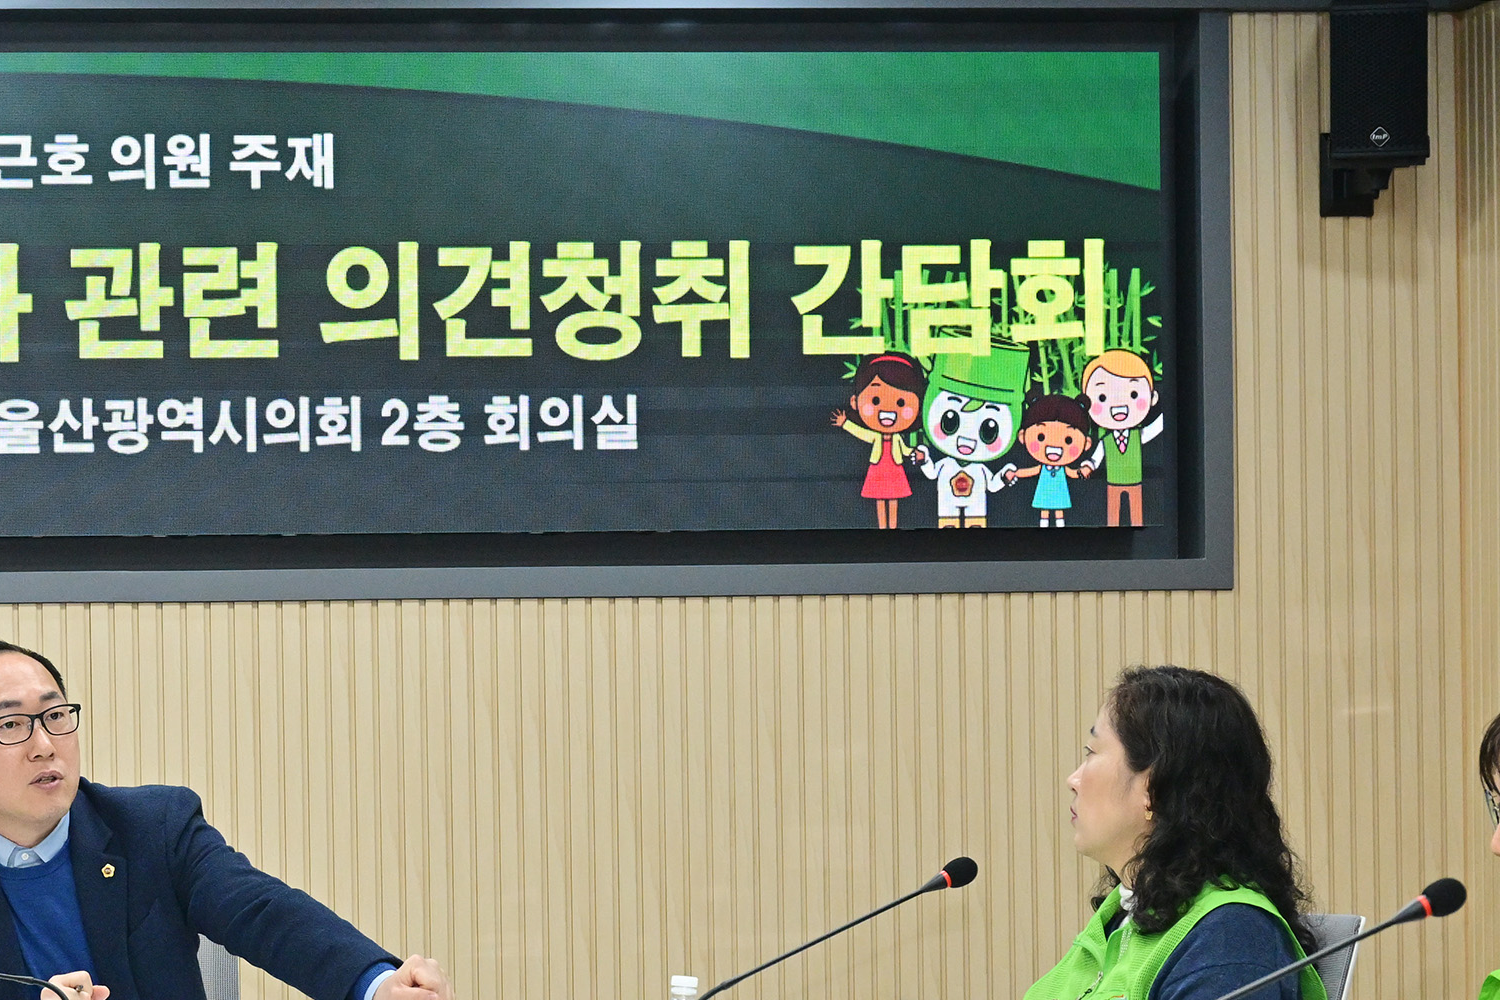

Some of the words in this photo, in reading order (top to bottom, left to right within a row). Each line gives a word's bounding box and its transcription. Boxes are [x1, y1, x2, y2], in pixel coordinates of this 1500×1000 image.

[107, 133, 211, 190] 의원
[229, 132, 334, 190] 주재
[64, 241, 279, 361] 관련
[319, 240, 750, 361] 의견청취
[790, 238, 1106, 357] 간담회
[381, 395, 465, 453] 2층
[483, 394, 638, 451] 회의실
